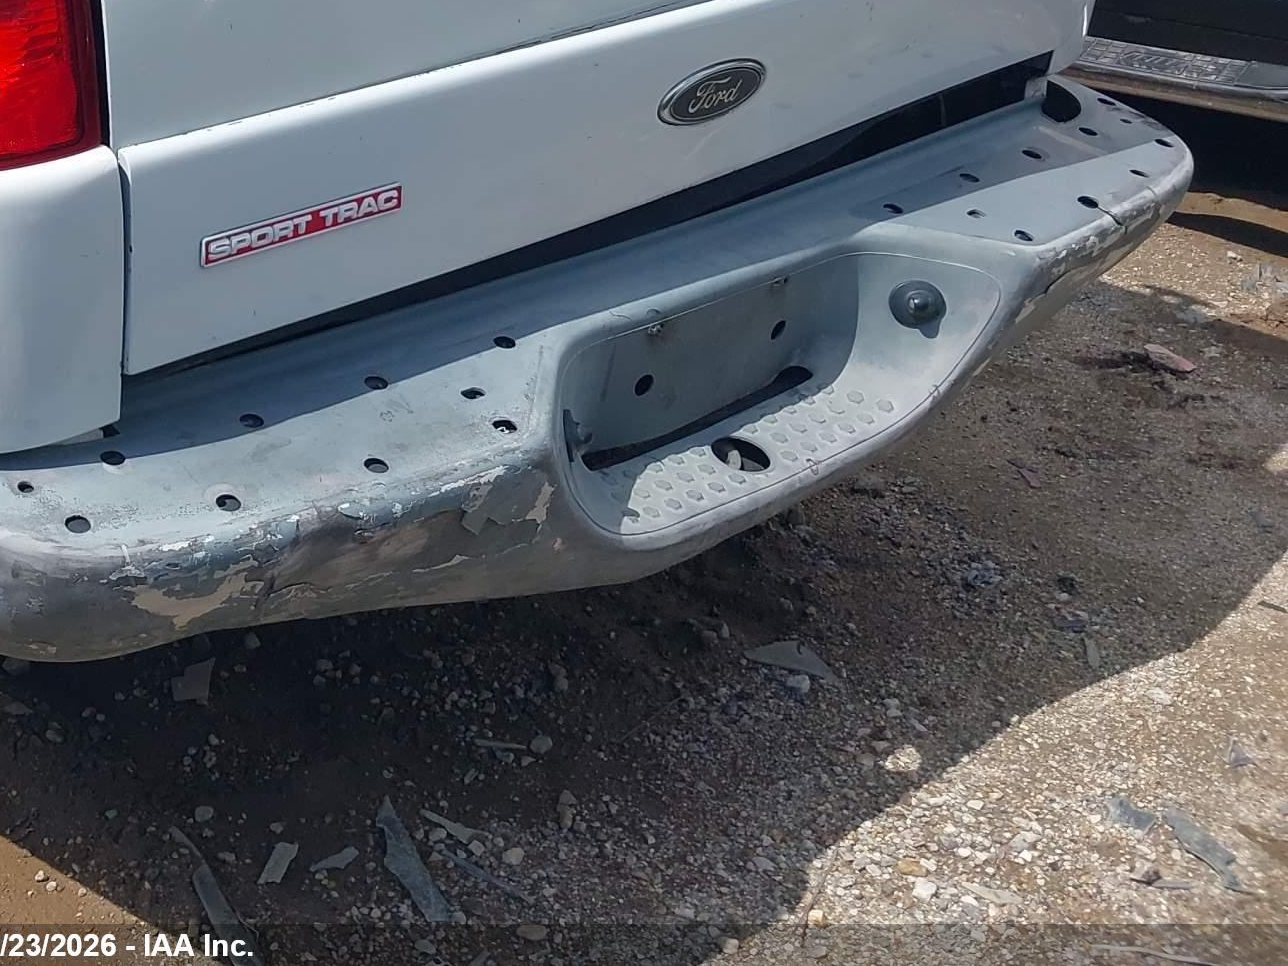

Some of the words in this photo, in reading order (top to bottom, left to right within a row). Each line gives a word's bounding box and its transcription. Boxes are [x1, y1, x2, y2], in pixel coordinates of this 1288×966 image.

[688, 75, 743, 114] Ford
[208, 214, 312, 261] SPORT
[319, 189, 399, 227] TRAC
